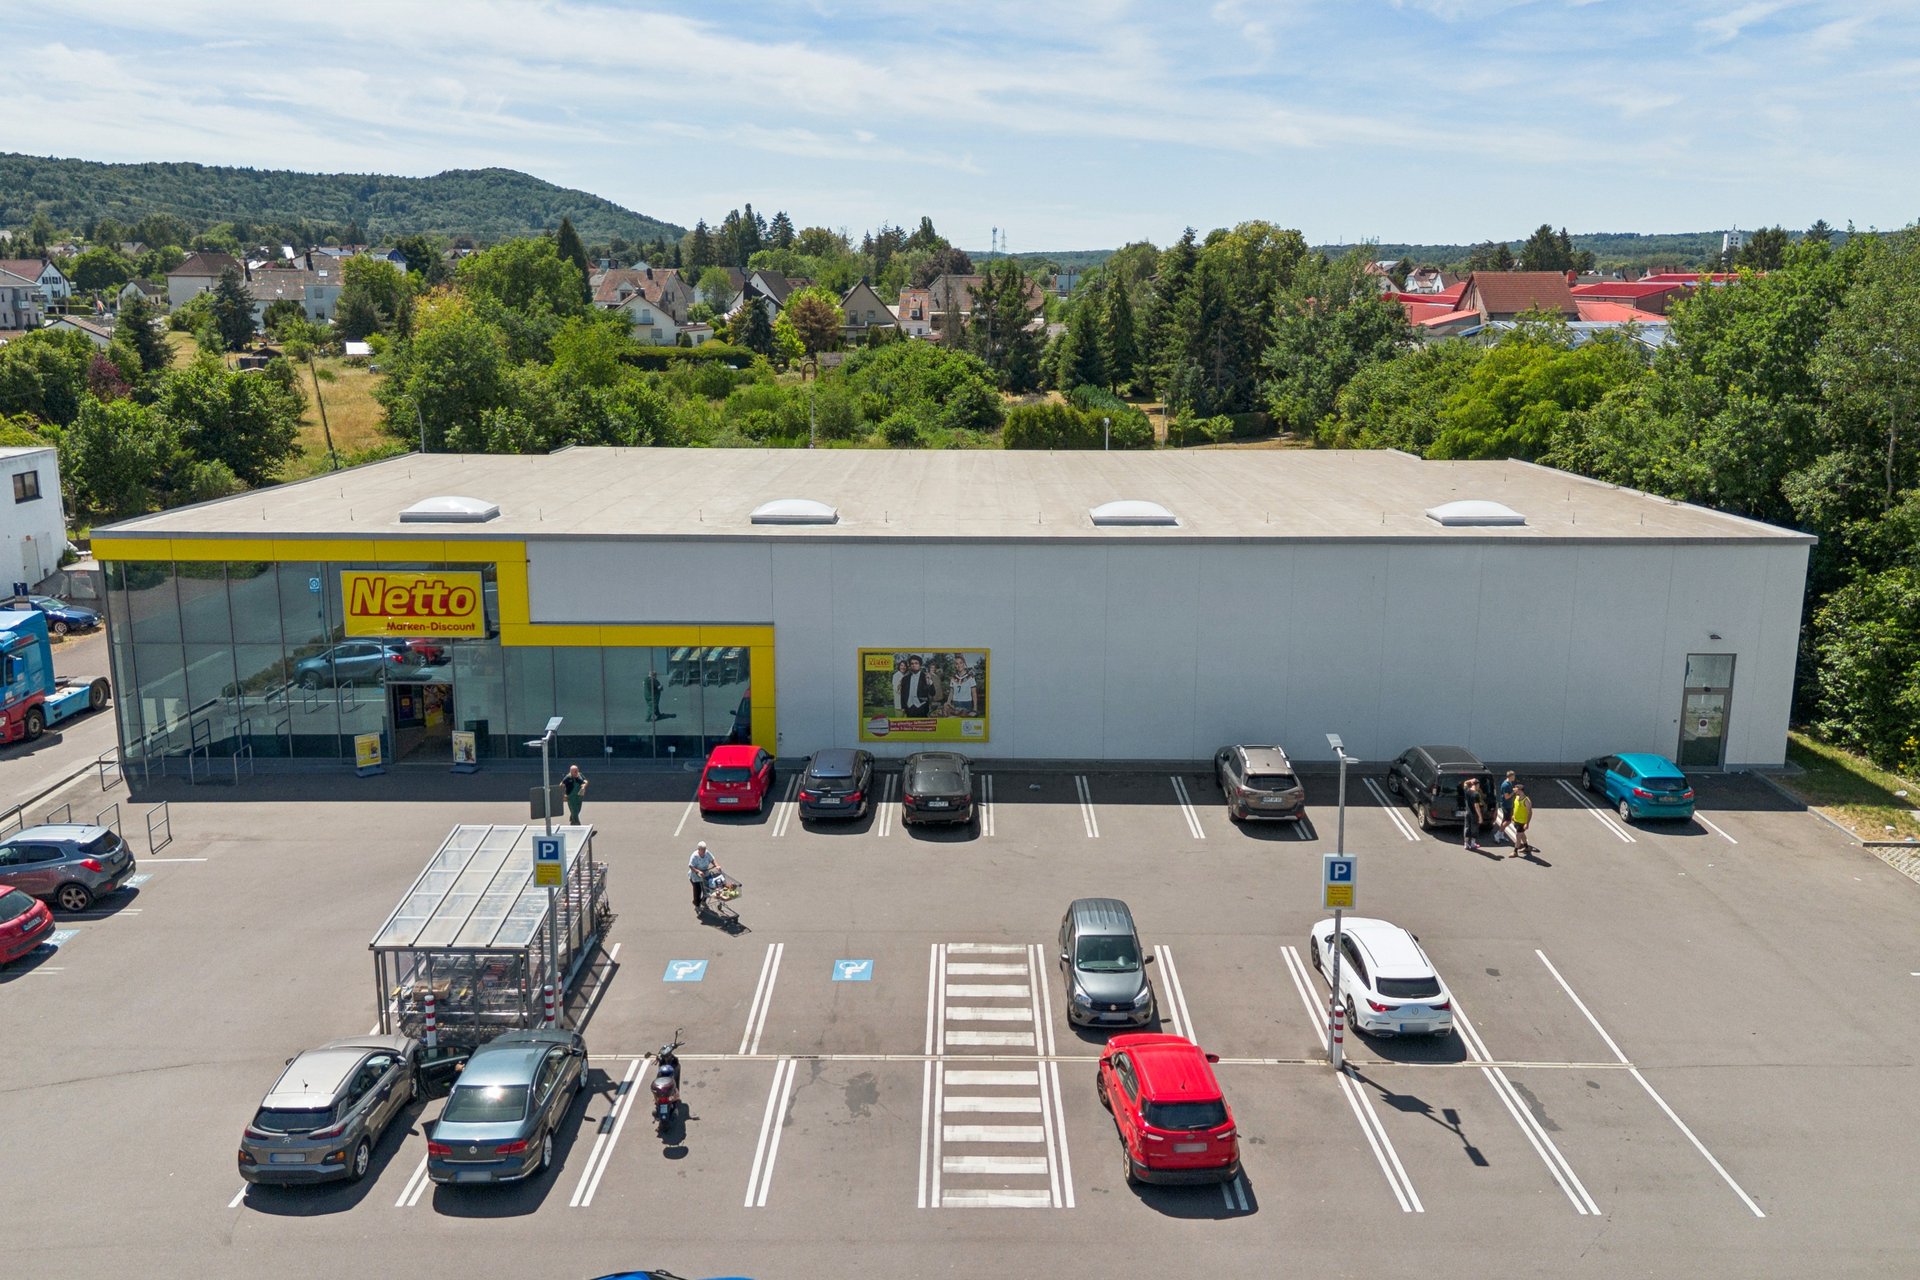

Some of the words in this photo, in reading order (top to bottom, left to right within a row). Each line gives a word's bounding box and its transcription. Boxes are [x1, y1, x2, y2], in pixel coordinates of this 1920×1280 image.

[350, 577, 476, 616] Netto
[386, 621, 475, 631] Marken-Discount
[543, 843, 555, 859] P
[1335, 864, 1347, 879] P
